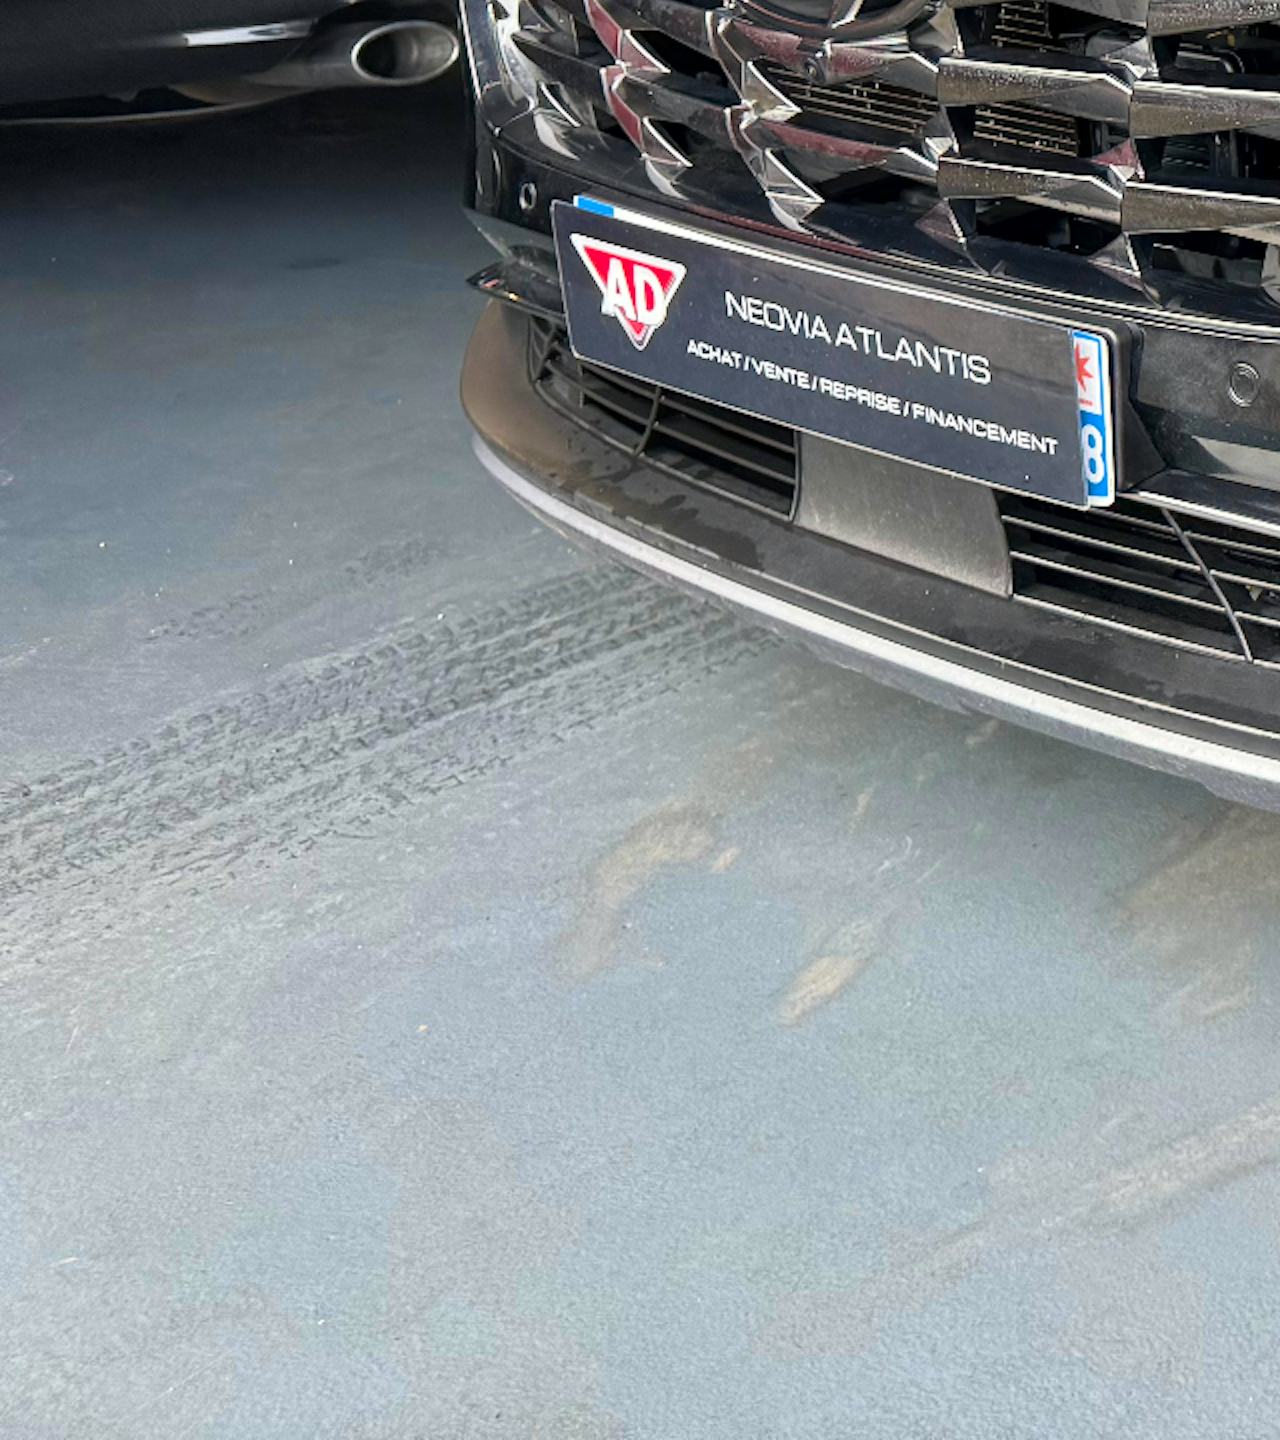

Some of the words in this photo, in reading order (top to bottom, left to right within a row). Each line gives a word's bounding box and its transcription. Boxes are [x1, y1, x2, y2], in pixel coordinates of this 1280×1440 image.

[601, 257, 667, 327] AD
[724, 290, 832, 344] NEOVIA
[835, 323, 992, 385] ATLANTIS
[687, 339, 741, 369] ACHAT
[751, 356, 810, 389] VENTE
[819, 377, 901, 416] REPRISE
[913, 403, 1059, 456] FINANCEMENT
